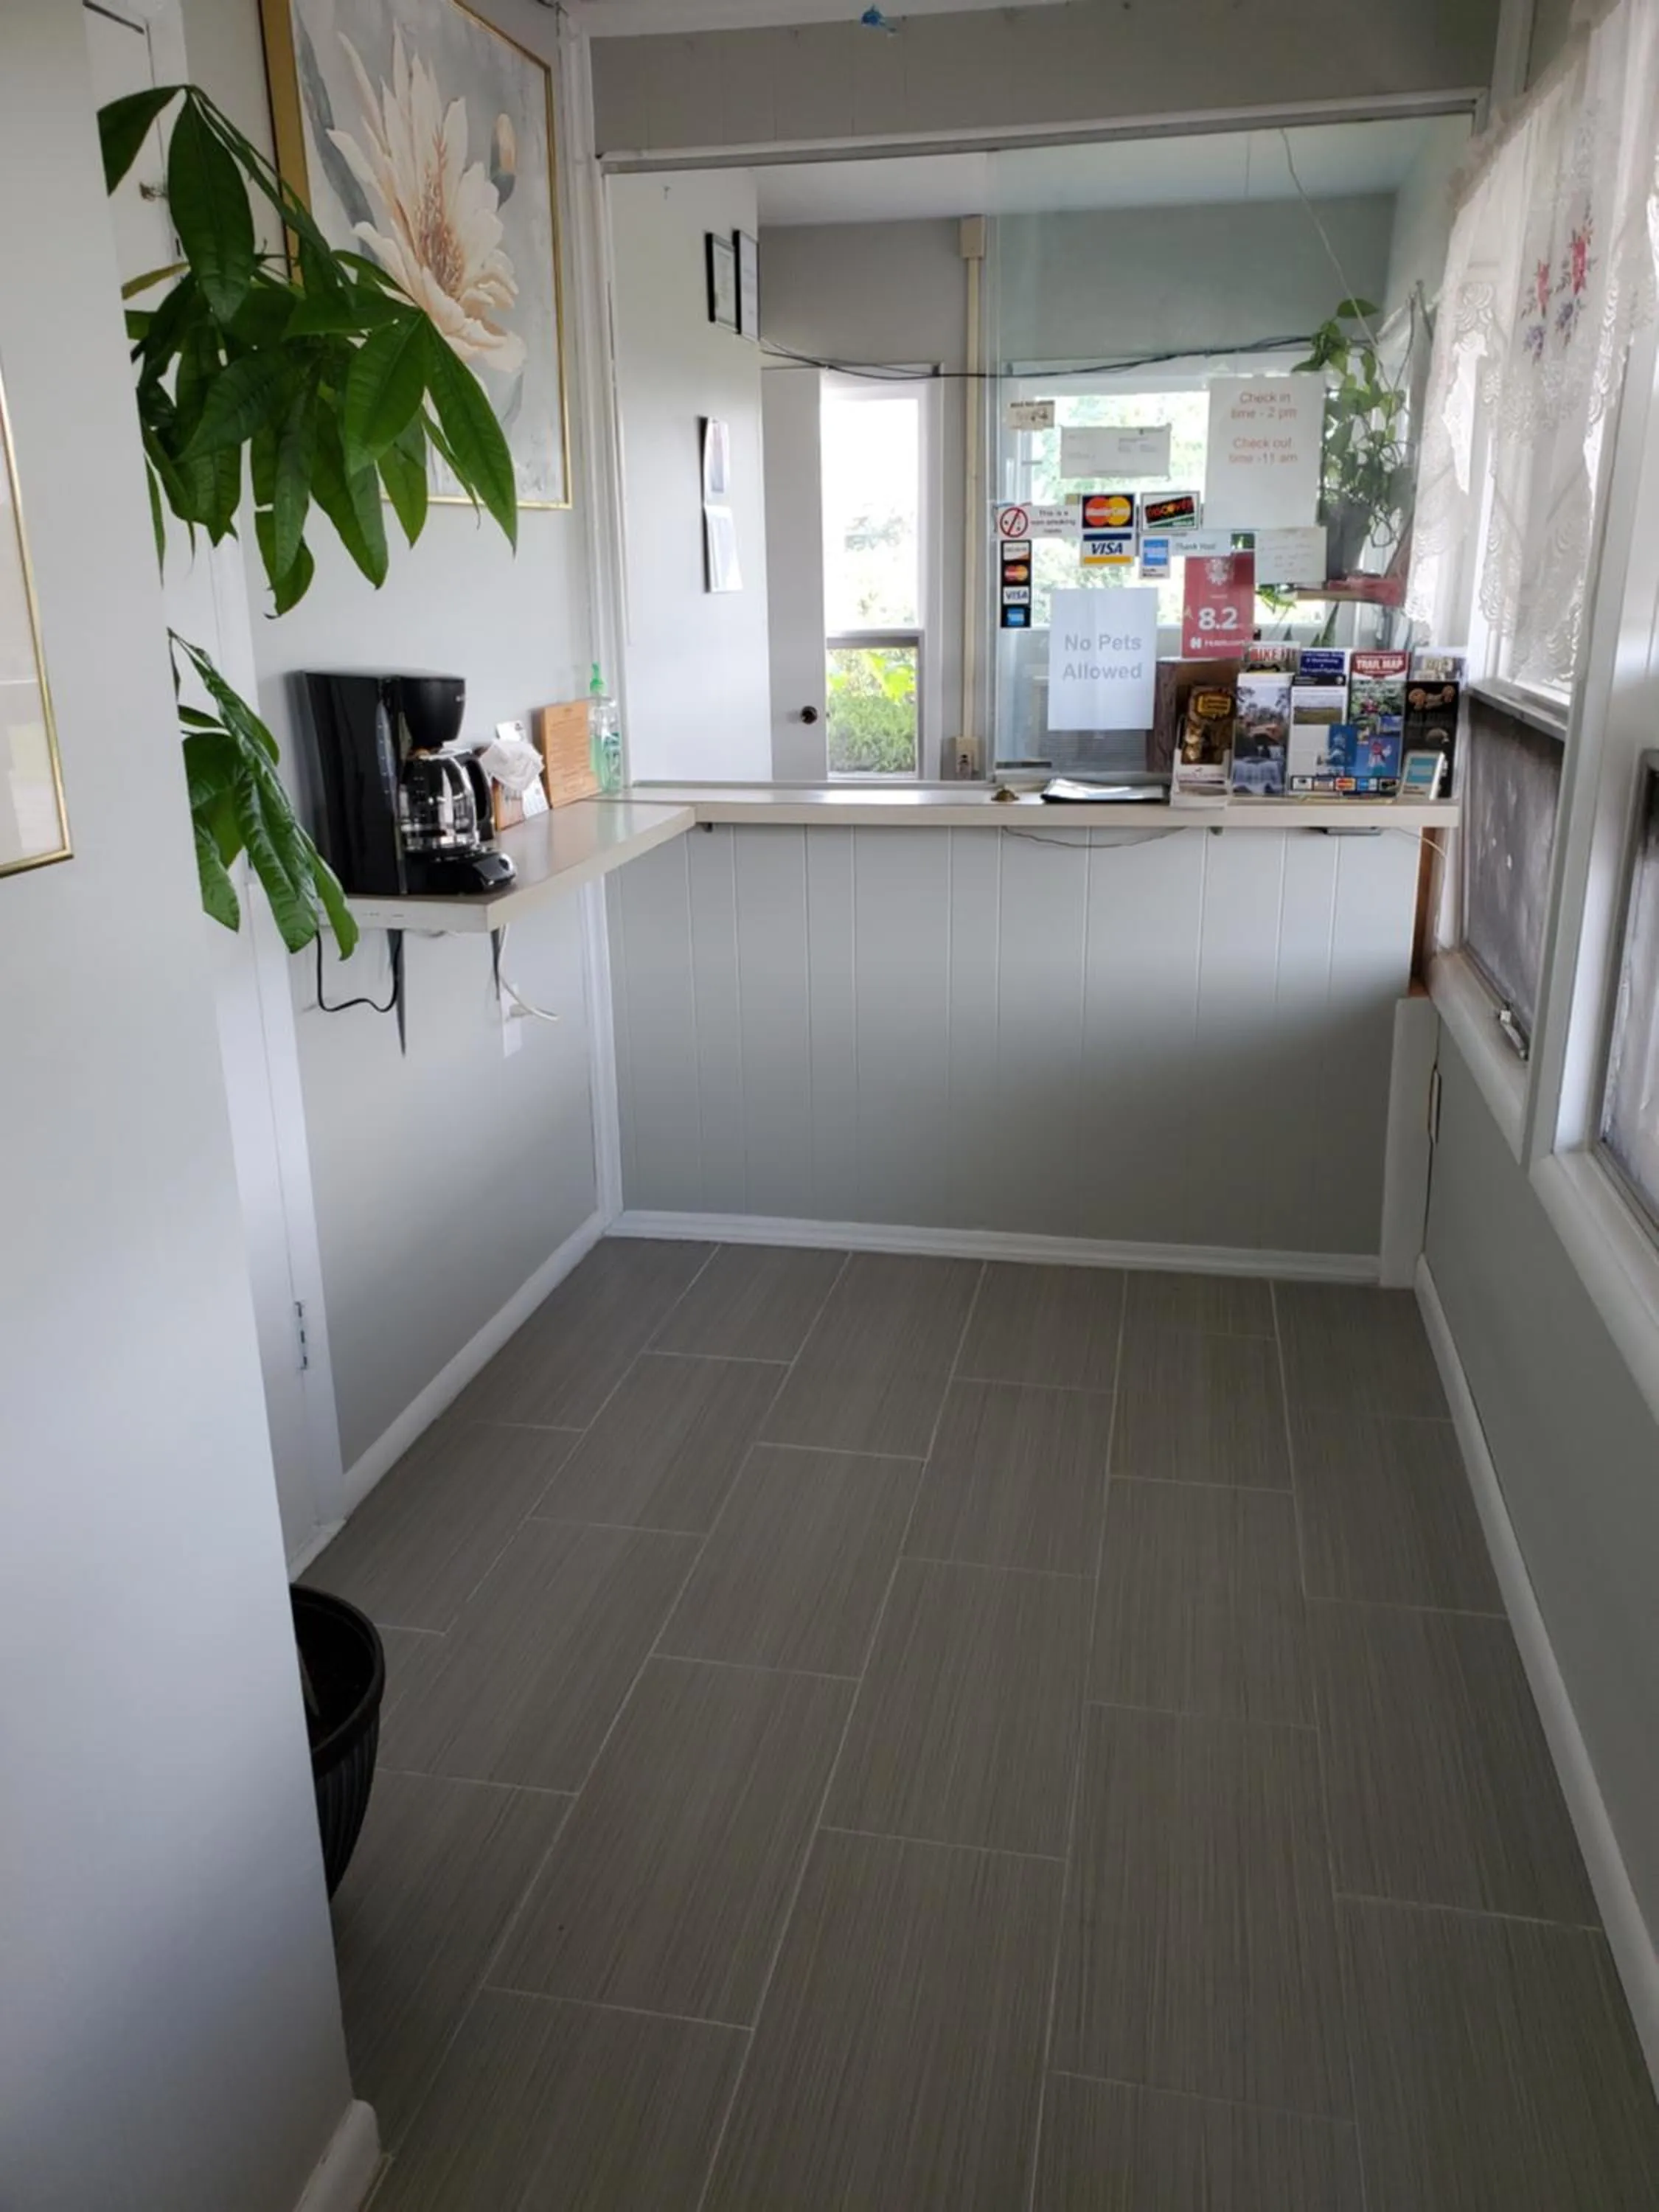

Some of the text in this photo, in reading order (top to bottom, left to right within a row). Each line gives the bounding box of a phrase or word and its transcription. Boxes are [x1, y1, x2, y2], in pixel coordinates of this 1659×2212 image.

[1239, 391, 1291, 404] Check in
[1231, 407, 1256, 419] time
[1278, 408, 1298, 421] pm
[1233, 437, 1292, 449] Check out
[1228, 453, 1254, 465] time
[1279, 453, 1298, 463] am
[1091, 542, 1123, 554] VISA
[1005, 591, 1028, 600] VISA
[1198, 607, 1239, 630] 8.2
[1064, 633, 1142, 651] No Pets
[1356, 658, 1380, 670] TRAIL
[1382, 658, 1403, 669] MAP
[1062, 662, 1142, 681] Allowed
